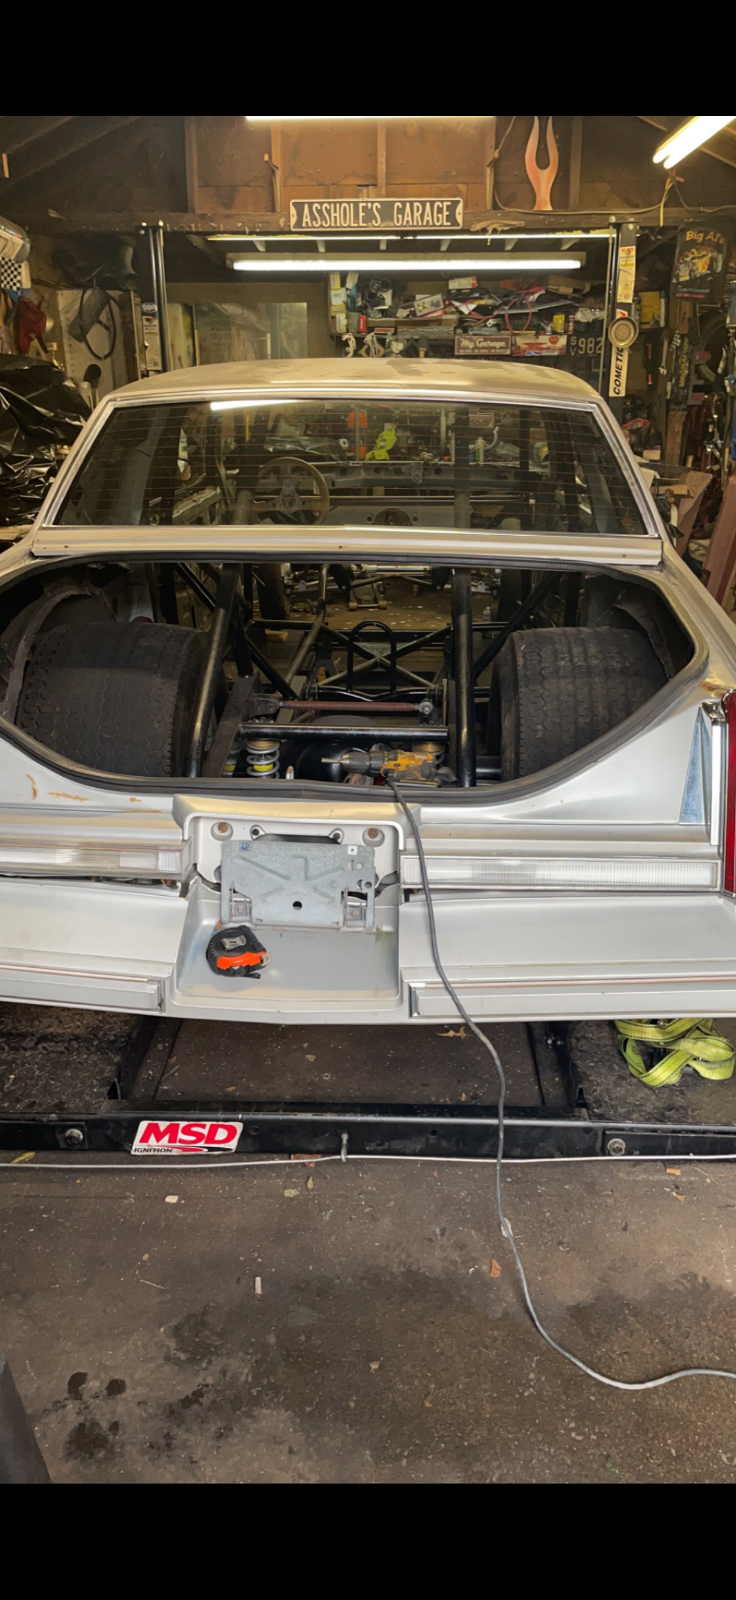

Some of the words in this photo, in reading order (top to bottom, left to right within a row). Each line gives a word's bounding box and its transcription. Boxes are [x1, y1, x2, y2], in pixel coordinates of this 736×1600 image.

[302, 202, 382, 228] ASSHOLE'S
[393, 201, 452, 227] GARAGE
[685, 230, 704, 243] Big
[459, 338, 475, 349] My
[476, 337, 506, 349] Garage
[138, 1122, 238, 1145] MSD
